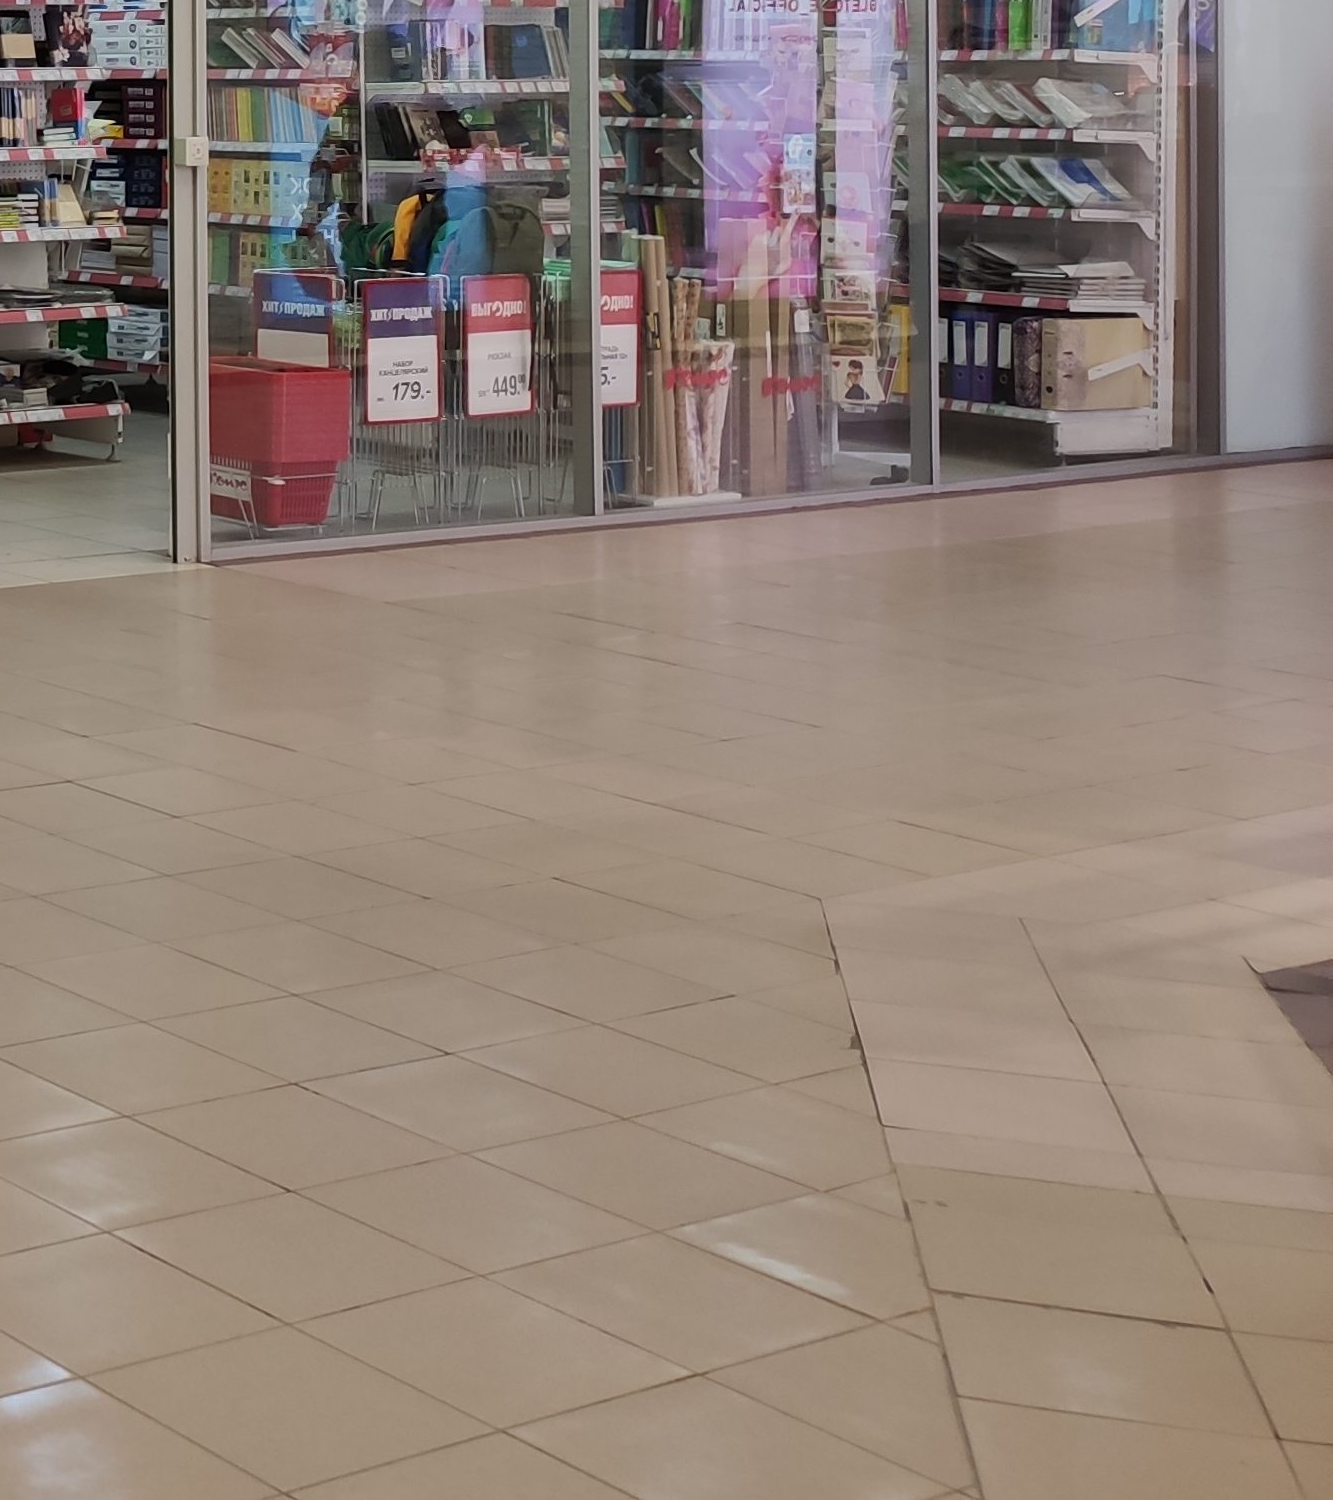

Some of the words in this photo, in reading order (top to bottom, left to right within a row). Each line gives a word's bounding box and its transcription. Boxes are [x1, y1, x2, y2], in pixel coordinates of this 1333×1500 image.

[261, 300, 279, 315] ХИТ
[284, 301, 326, 318] ПРОДАЖ
[471, 300, 527, 317] ВЫГОДНО!
[600, 294, 634, 312] ОДНО!
[370, 308, 387, 322] ХИТ
[392, 306, 433, 322] ПРОДАЖ
